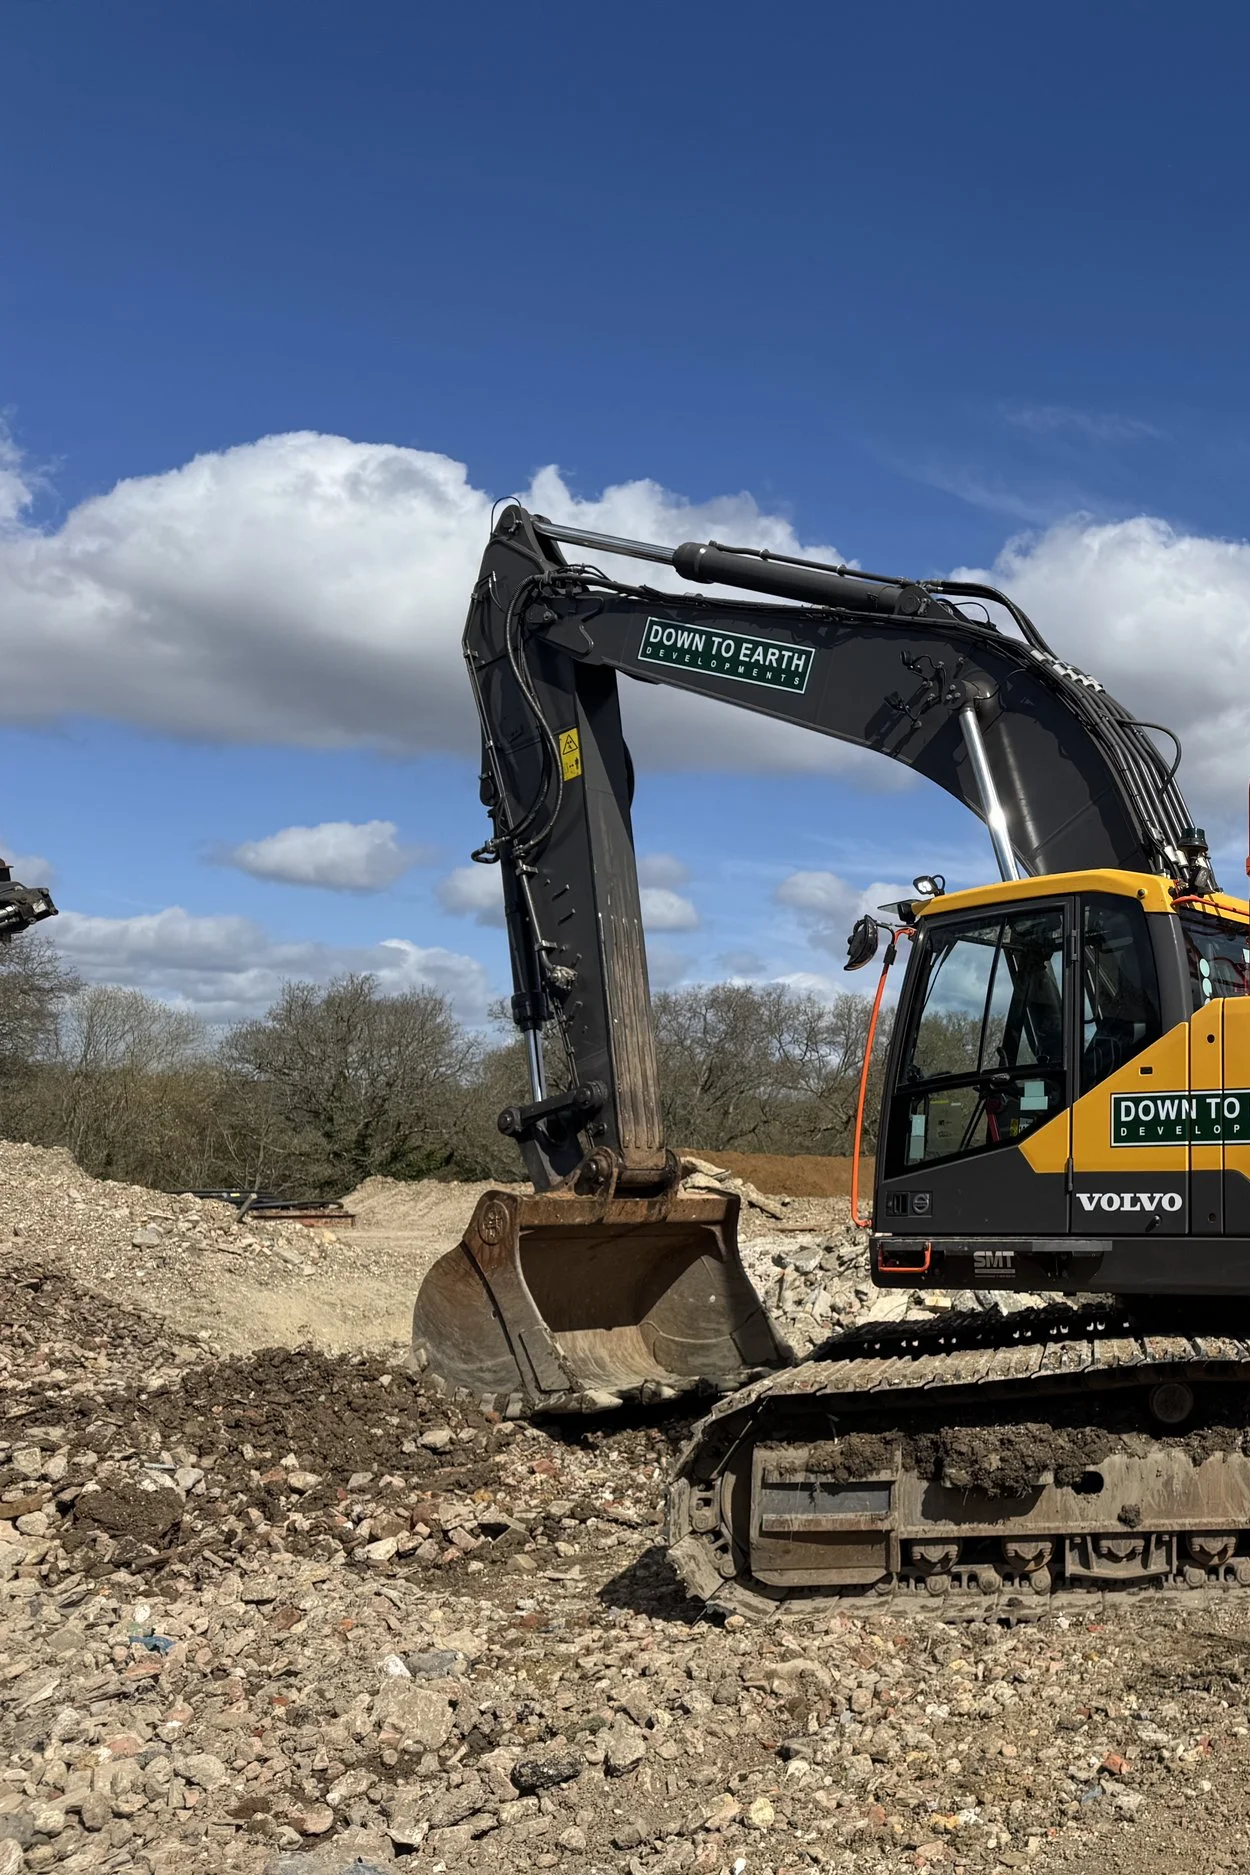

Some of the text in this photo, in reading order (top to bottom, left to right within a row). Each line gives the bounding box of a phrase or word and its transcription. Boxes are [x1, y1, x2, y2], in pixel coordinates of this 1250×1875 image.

[650, 625, 806, 672] DOWN TO EARTH
[646, 646, 800, 685] DEVELOPMENTS
[1120, 1099, 1197, 1122] DOWN
[1206, 1097, 1240, 1119] TO
[1076, 1193, 1183, 1211] VOLVO
[973, 1251, 1015, 1268] SMT
